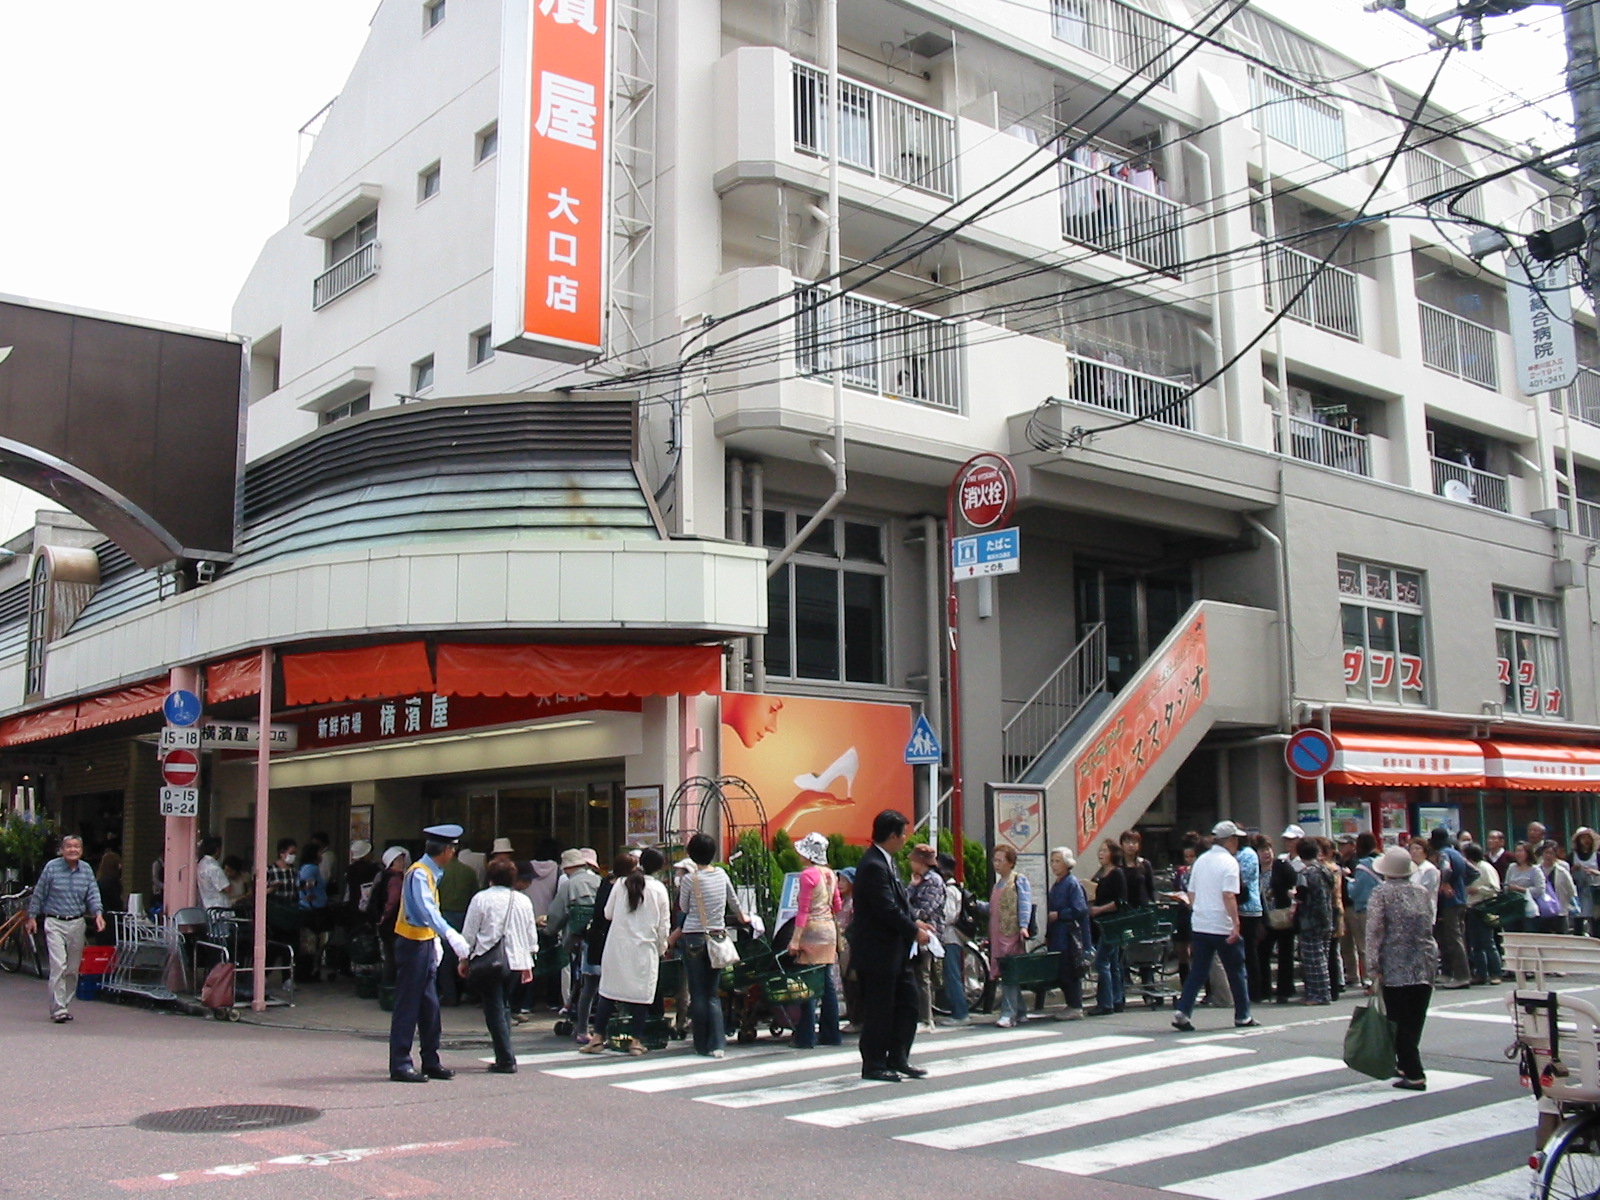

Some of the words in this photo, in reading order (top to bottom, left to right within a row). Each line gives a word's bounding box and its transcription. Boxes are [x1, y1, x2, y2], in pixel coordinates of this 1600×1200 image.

[546, 187, 581, 314] 大口店
[964, 481, 1003, 511] 消火栓
[986, 537, 1012, 552] たばこ
[1344, 646, 1423, 691] ダンス
[318, 712, 361, 738] 新鮮市場
[380, 692, 449, 735] 横濱屋
[164, 731, 198, 745] 15-18
[164, 790, 195, 801] 0-15
[162, 802, 195, 814] 18-24
